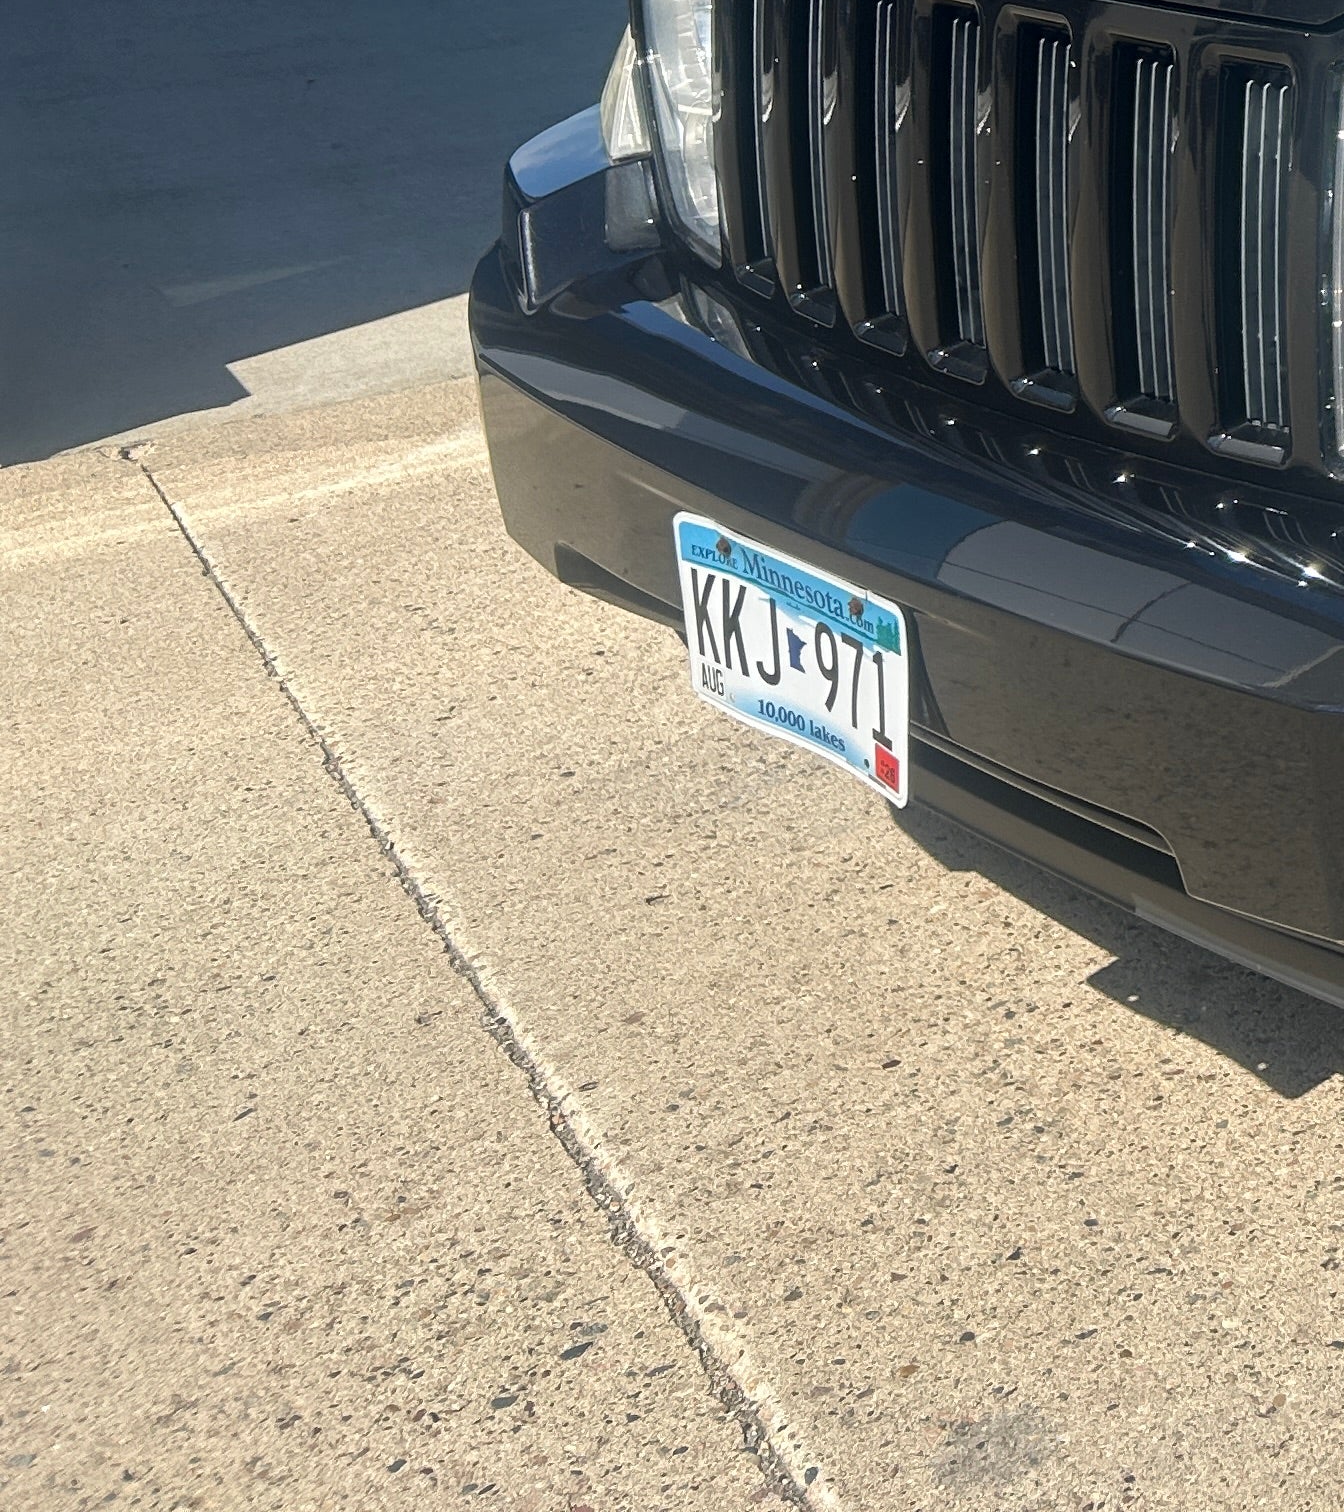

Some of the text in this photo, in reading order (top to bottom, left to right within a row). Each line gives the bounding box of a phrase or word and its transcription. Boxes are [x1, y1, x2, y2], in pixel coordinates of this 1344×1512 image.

[691, 543, 738, 570] EXPLORE
[690, 567, 894, 751] KKJ 971
[701, 662, 725, 698] AUG
[756, 698, 846, 752] 10,000 lakes
